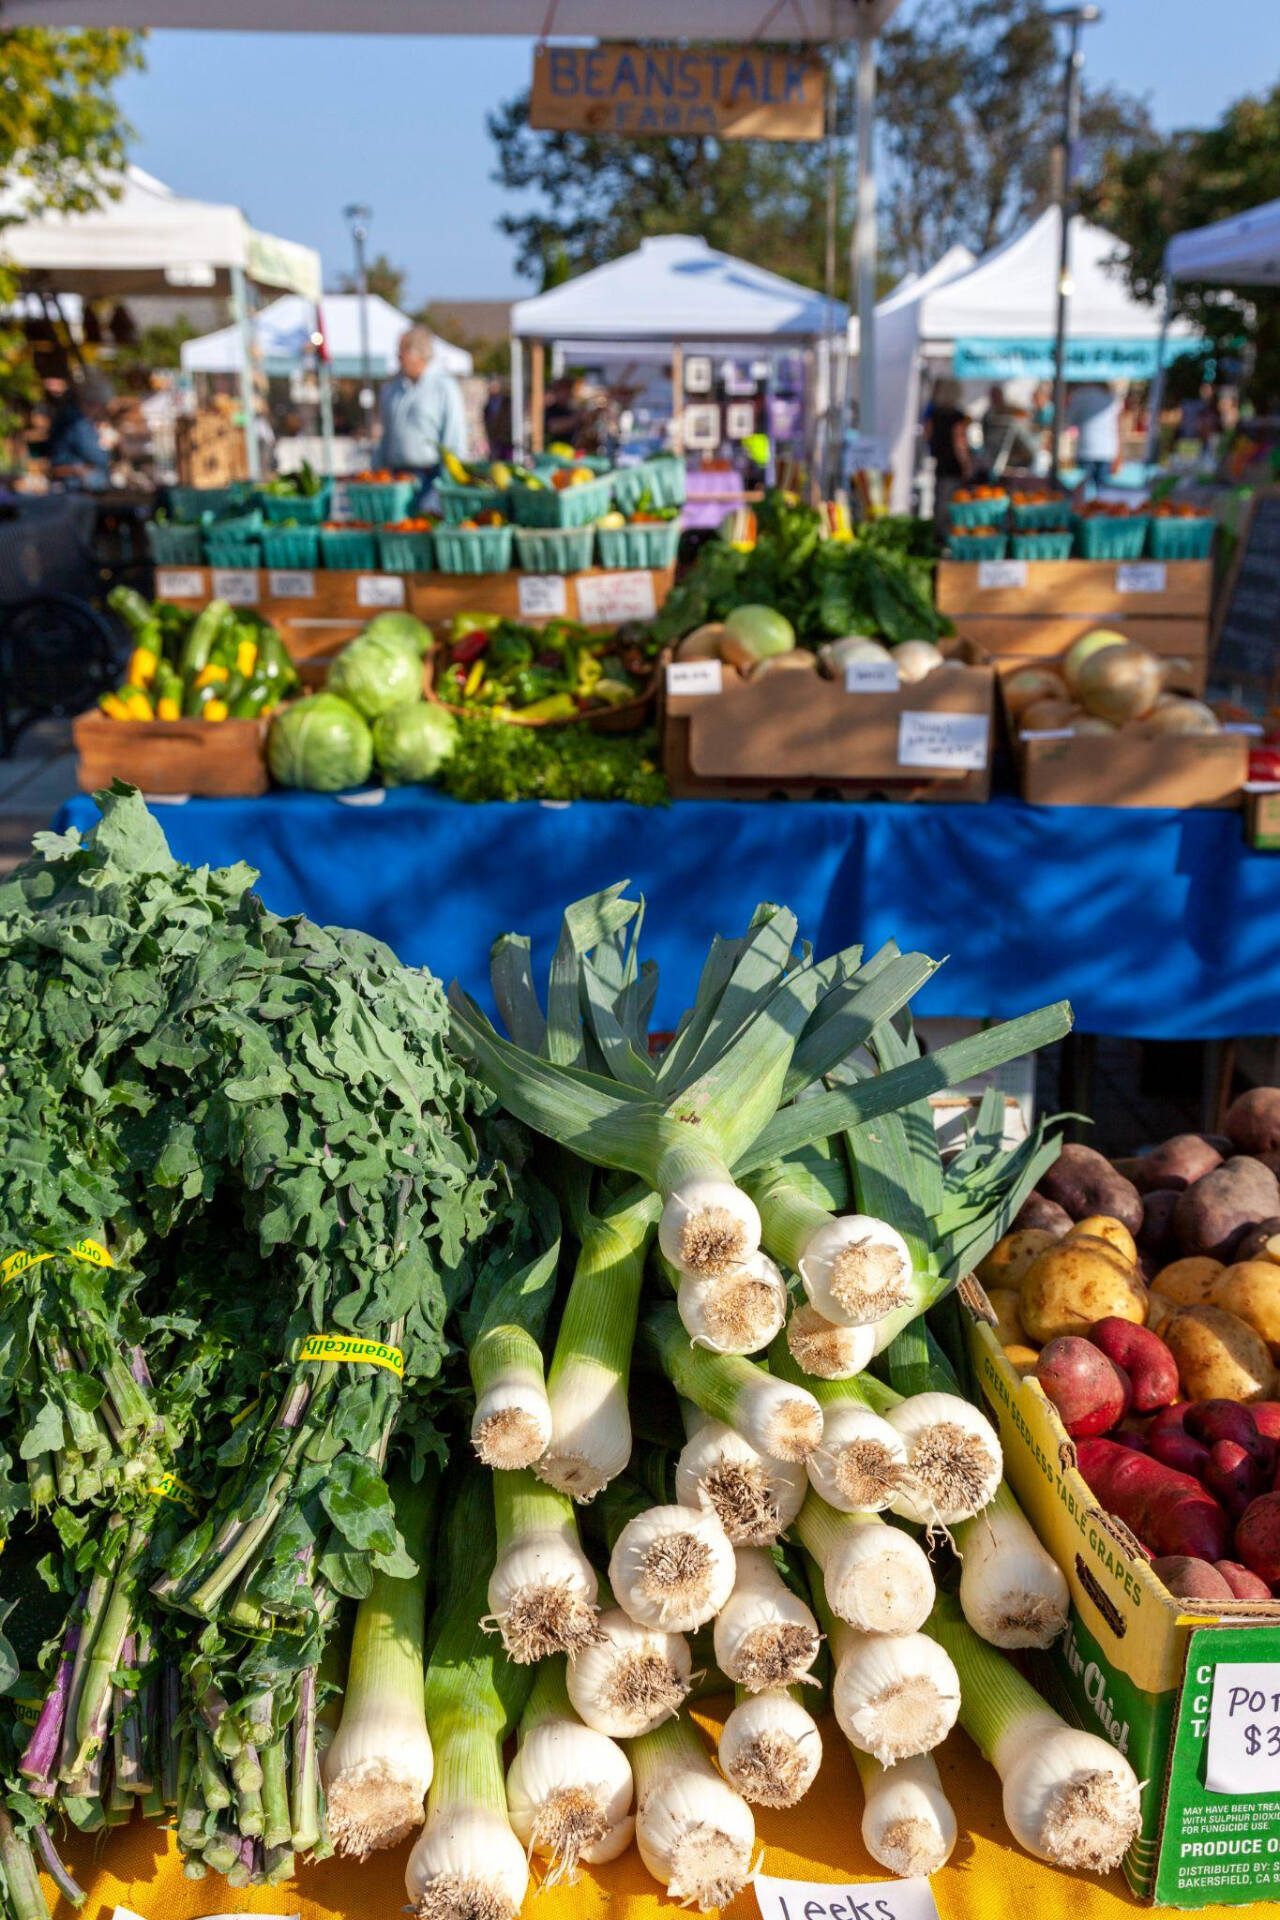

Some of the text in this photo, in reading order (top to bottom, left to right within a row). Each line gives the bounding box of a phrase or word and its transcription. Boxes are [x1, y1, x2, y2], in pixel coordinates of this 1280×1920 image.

[550, 51, 807, 103] BEANSTALK
[615, 102, 718, 130] FARM
[983, 1357, 1142, 1607] GREEN SEEDLESS TABLE GRAPES
[1228, 1686, 1280, 1718] POT
[1183, 1802, 1280, 1816] MAY HAVE BEEN TREA
[1182, 1812, 1280, 1825] WITH SULPHUR DIOXID
[1181, 1821, 1271, 1835] FOR FUNGICIDE USE.
[1180, 1838, 1280, 1858] PRODUCE O
[1178, 1863, 1250, 1877] DISTRIBUTED
[1178, 1874, 1253, 1889] BAKERSFIELD,
[1255, 1873, 1271, 1884] CA
